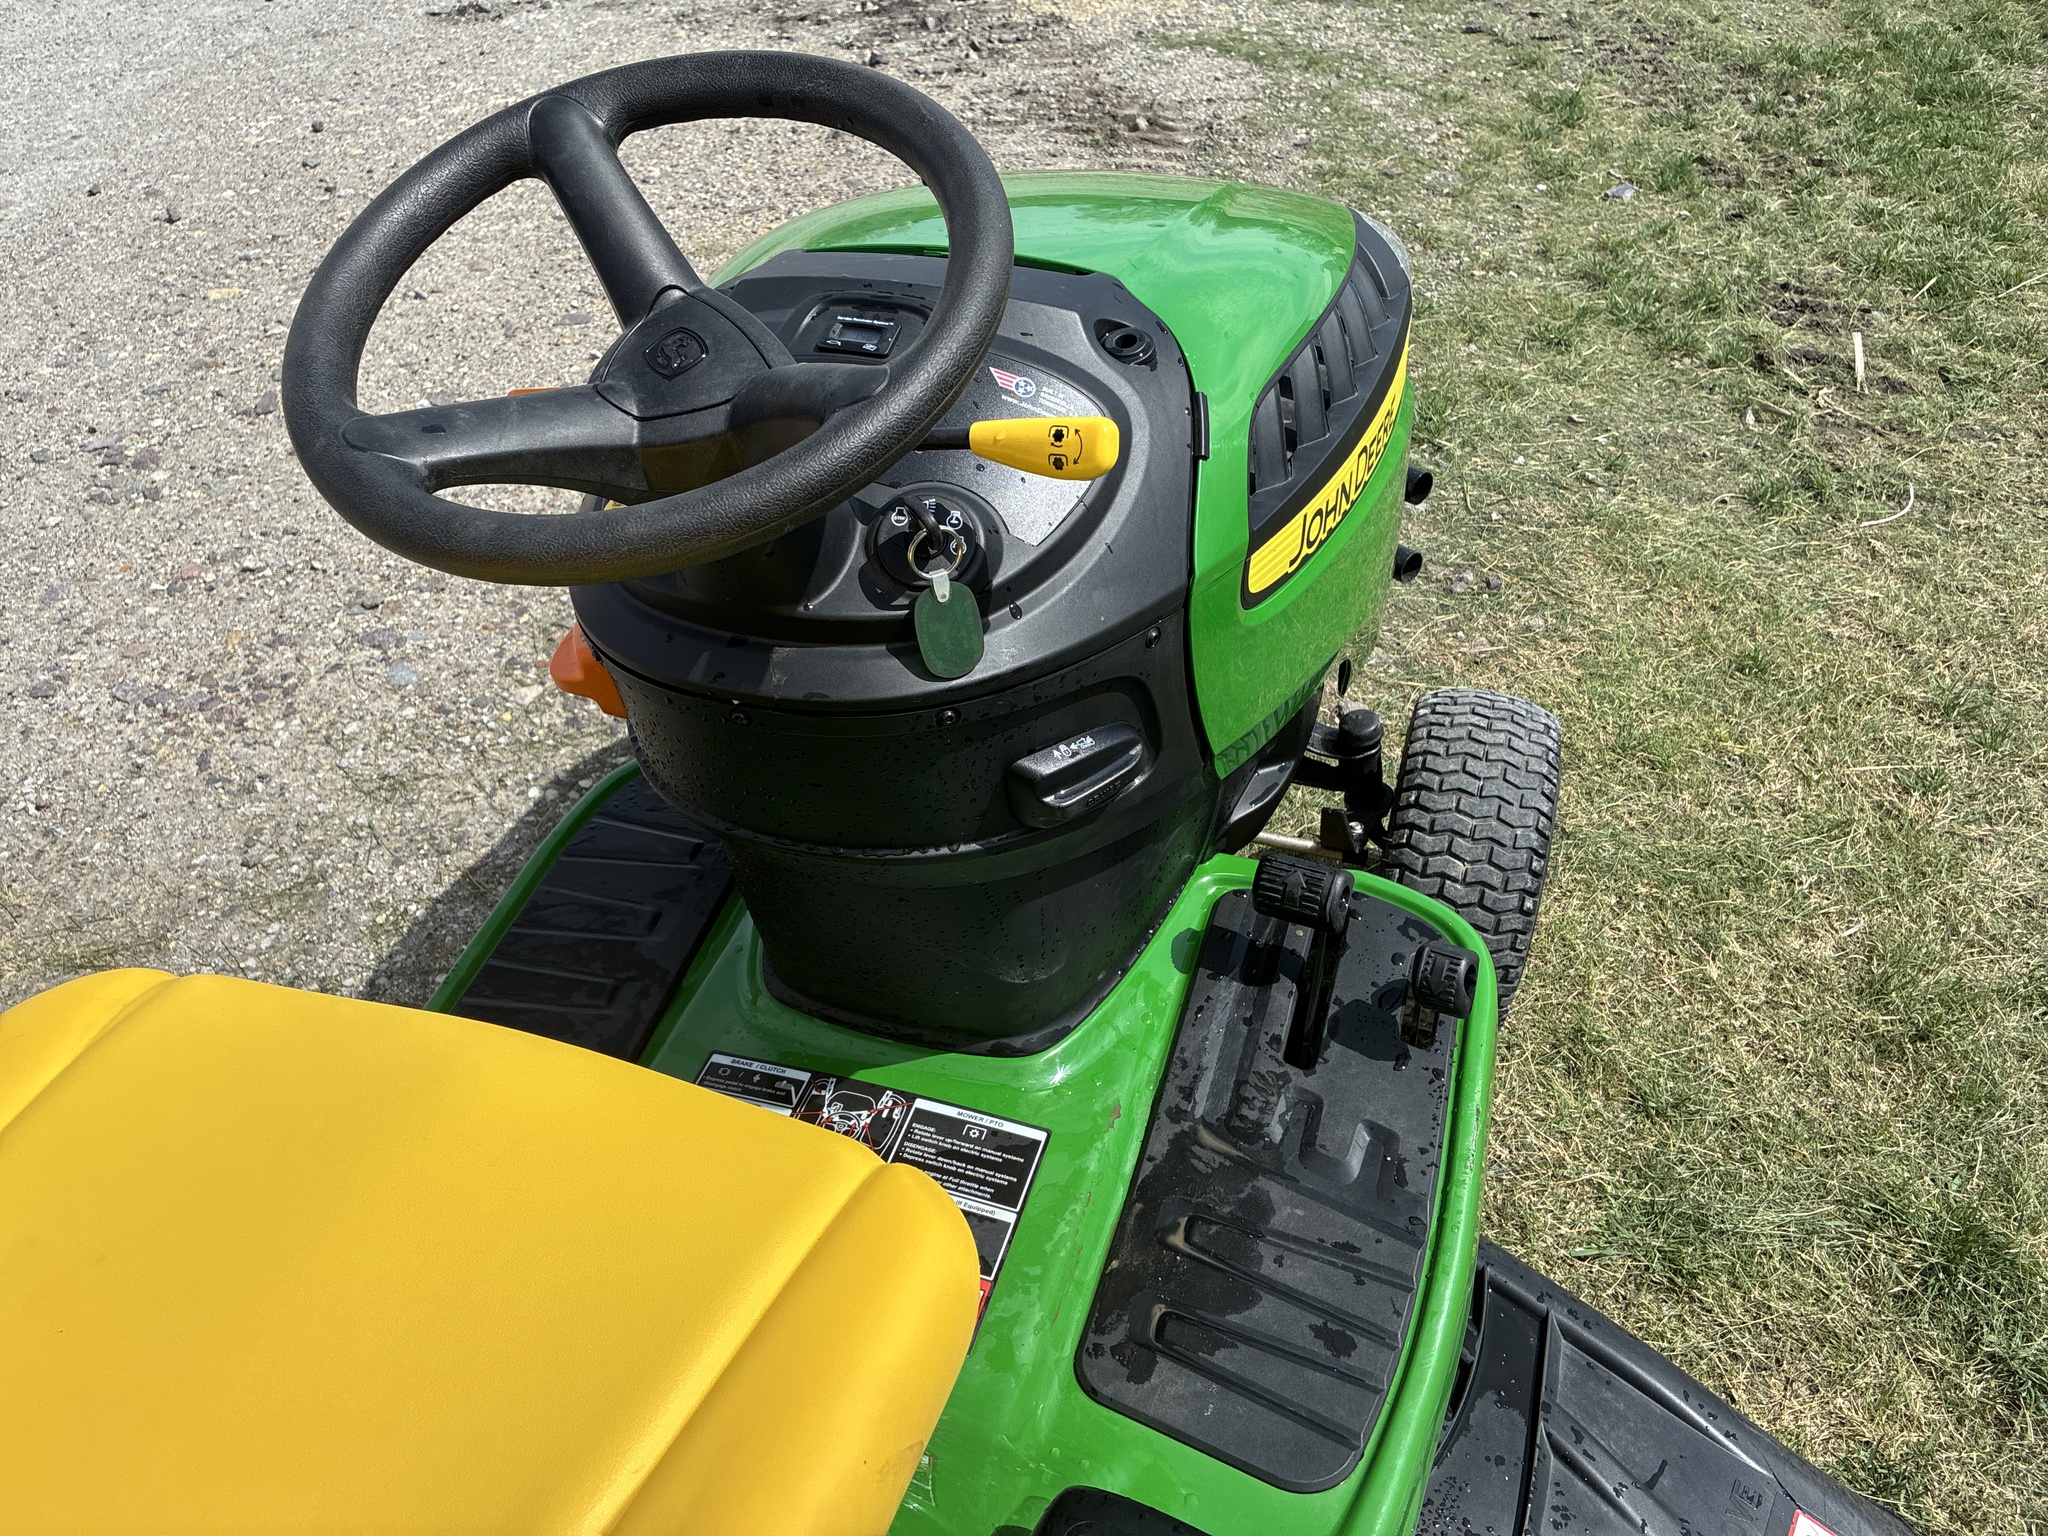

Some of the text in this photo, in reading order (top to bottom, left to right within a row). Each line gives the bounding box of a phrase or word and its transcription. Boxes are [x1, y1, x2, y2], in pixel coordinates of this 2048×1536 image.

[1289, 394, 1396, 568] JOHN DEERE
[731, 1059, 753, 1067] BRAKE
[760, 1065, 786, 1074] CLUTCH
[706, 1076, 725, 1084] Depress
[957, 1110, 985, 1122] MOWER
[989, 1120, 1004, 1128] PTO
[912, 1123, 936, 1133] ENGAGE:
[903, 1141, 937, 1154] DISENGAGE:
[913, 1128, 931, 1137] Rotate
[932, 1133, 945, 1141] lever
[982, 1147, 1002, 1156] manual
[1002, 1153, 1024, 1163] systems
[921, 1136, 938, 1144] switch
[960, 1147, 980, 1156] electric
[981, 1153, 1002, 1162] systems
[903, 1153, 925, 1163] Depress
[925, 1159, 942, 1167] switch
[965, 1170, 985, 1179] electric
[986, 1176, 1008, 1185] systems
[905, 1147, 923, 1156] Rotate
[923, 1152, 936, 1160] lever
[936, 1156, 966, 1167] down/back
[974, 1166, 994, 1175] manual
[994, 1172, 1017, 1182] systems
[942, 1181, 957, 1189] other
[959, 1179, 979, 1188] throttle
[979, 1185, 994, 1193] when
[963, 1202, 996, 1215] Equipped)
